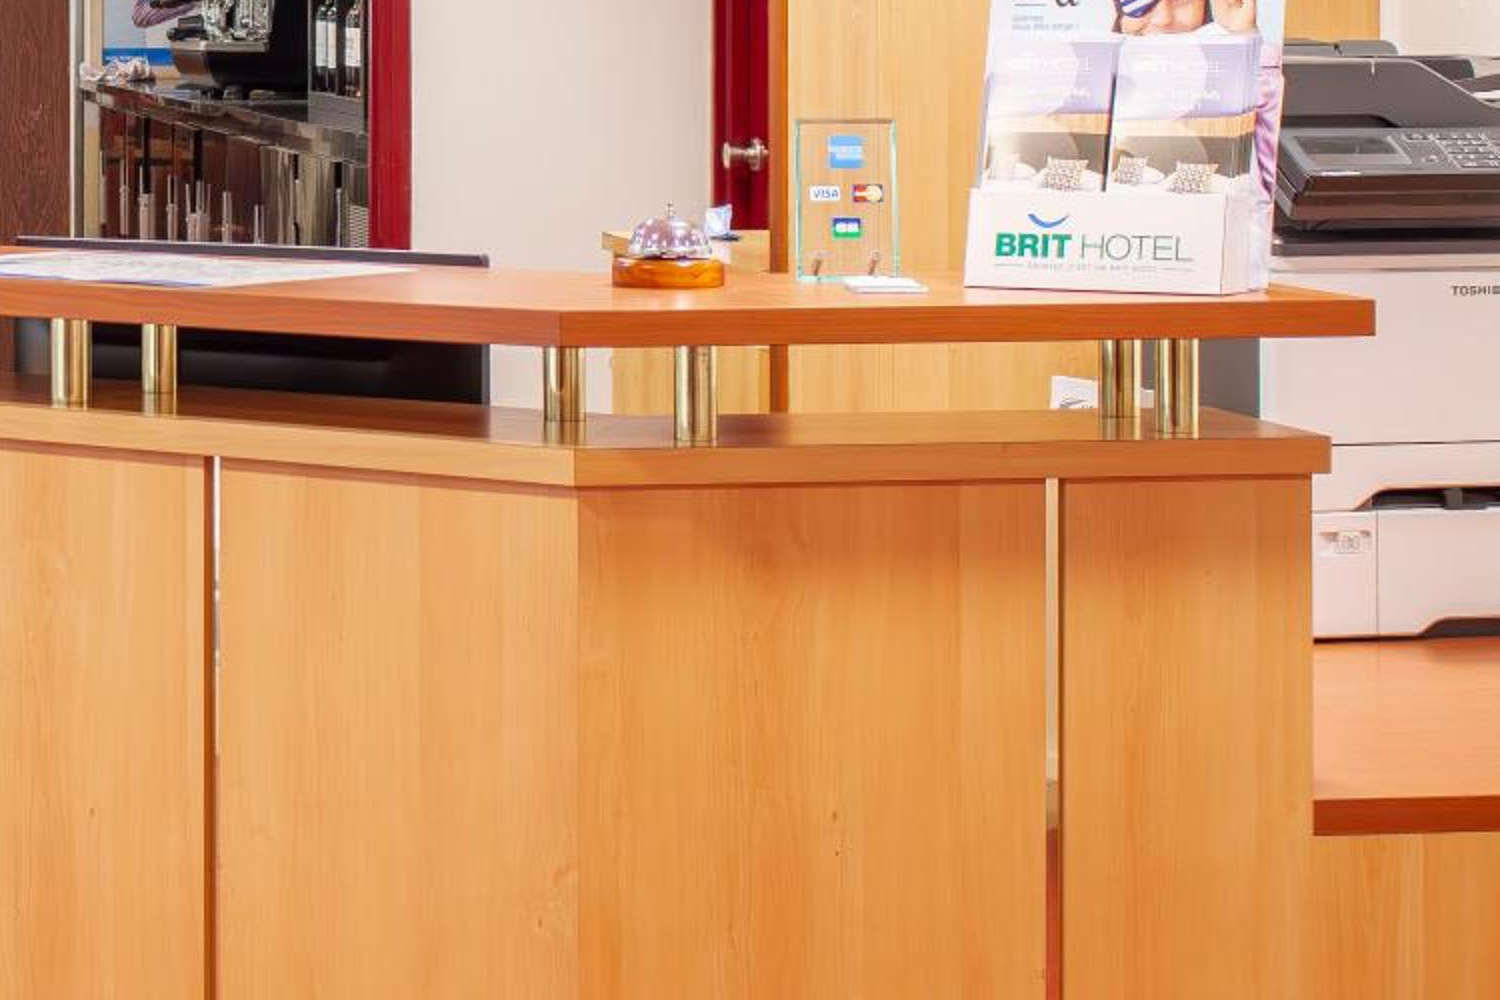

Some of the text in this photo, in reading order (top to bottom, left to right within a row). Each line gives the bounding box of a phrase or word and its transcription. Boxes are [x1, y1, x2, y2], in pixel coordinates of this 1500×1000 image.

[813, 189, 838, 199] VISA
[995, 233, 1193, 262] BRIT HOTEL
